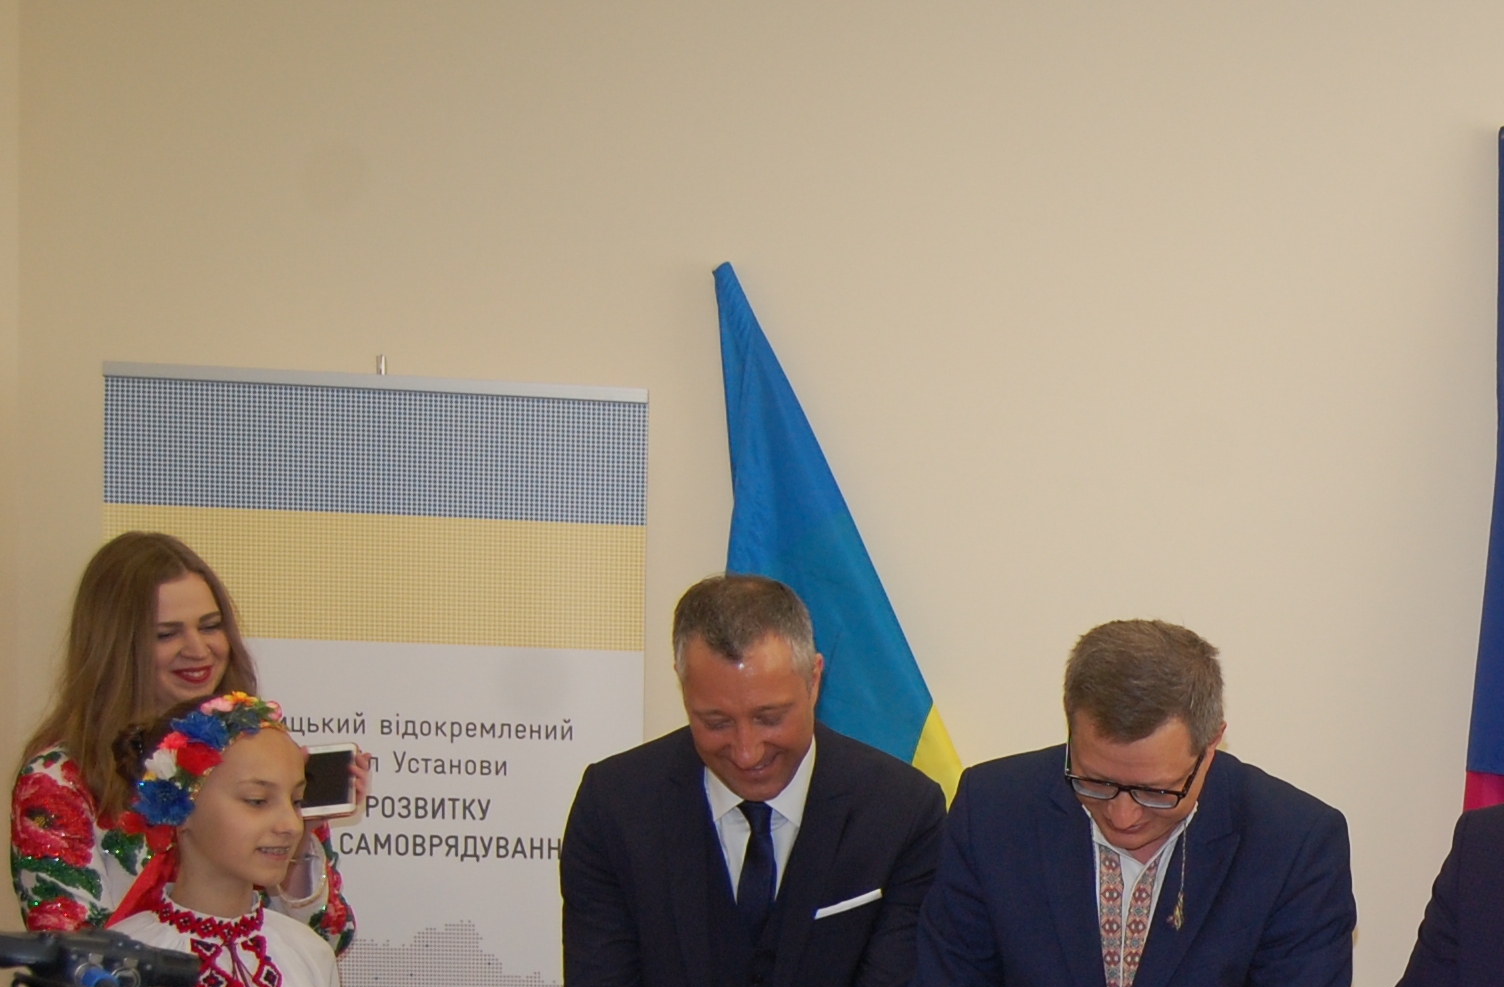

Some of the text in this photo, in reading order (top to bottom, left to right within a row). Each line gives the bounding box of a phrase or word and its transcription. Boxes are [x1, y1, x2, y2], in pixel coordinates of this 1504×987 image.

[380, 713, 574, 743] відокремлений
[392, 750, 508, 776] Установи
[365, 795, 491, 820] РОЗВИТКУ
[339, 832, 562, 862] САМОВРЯДУВАНН
